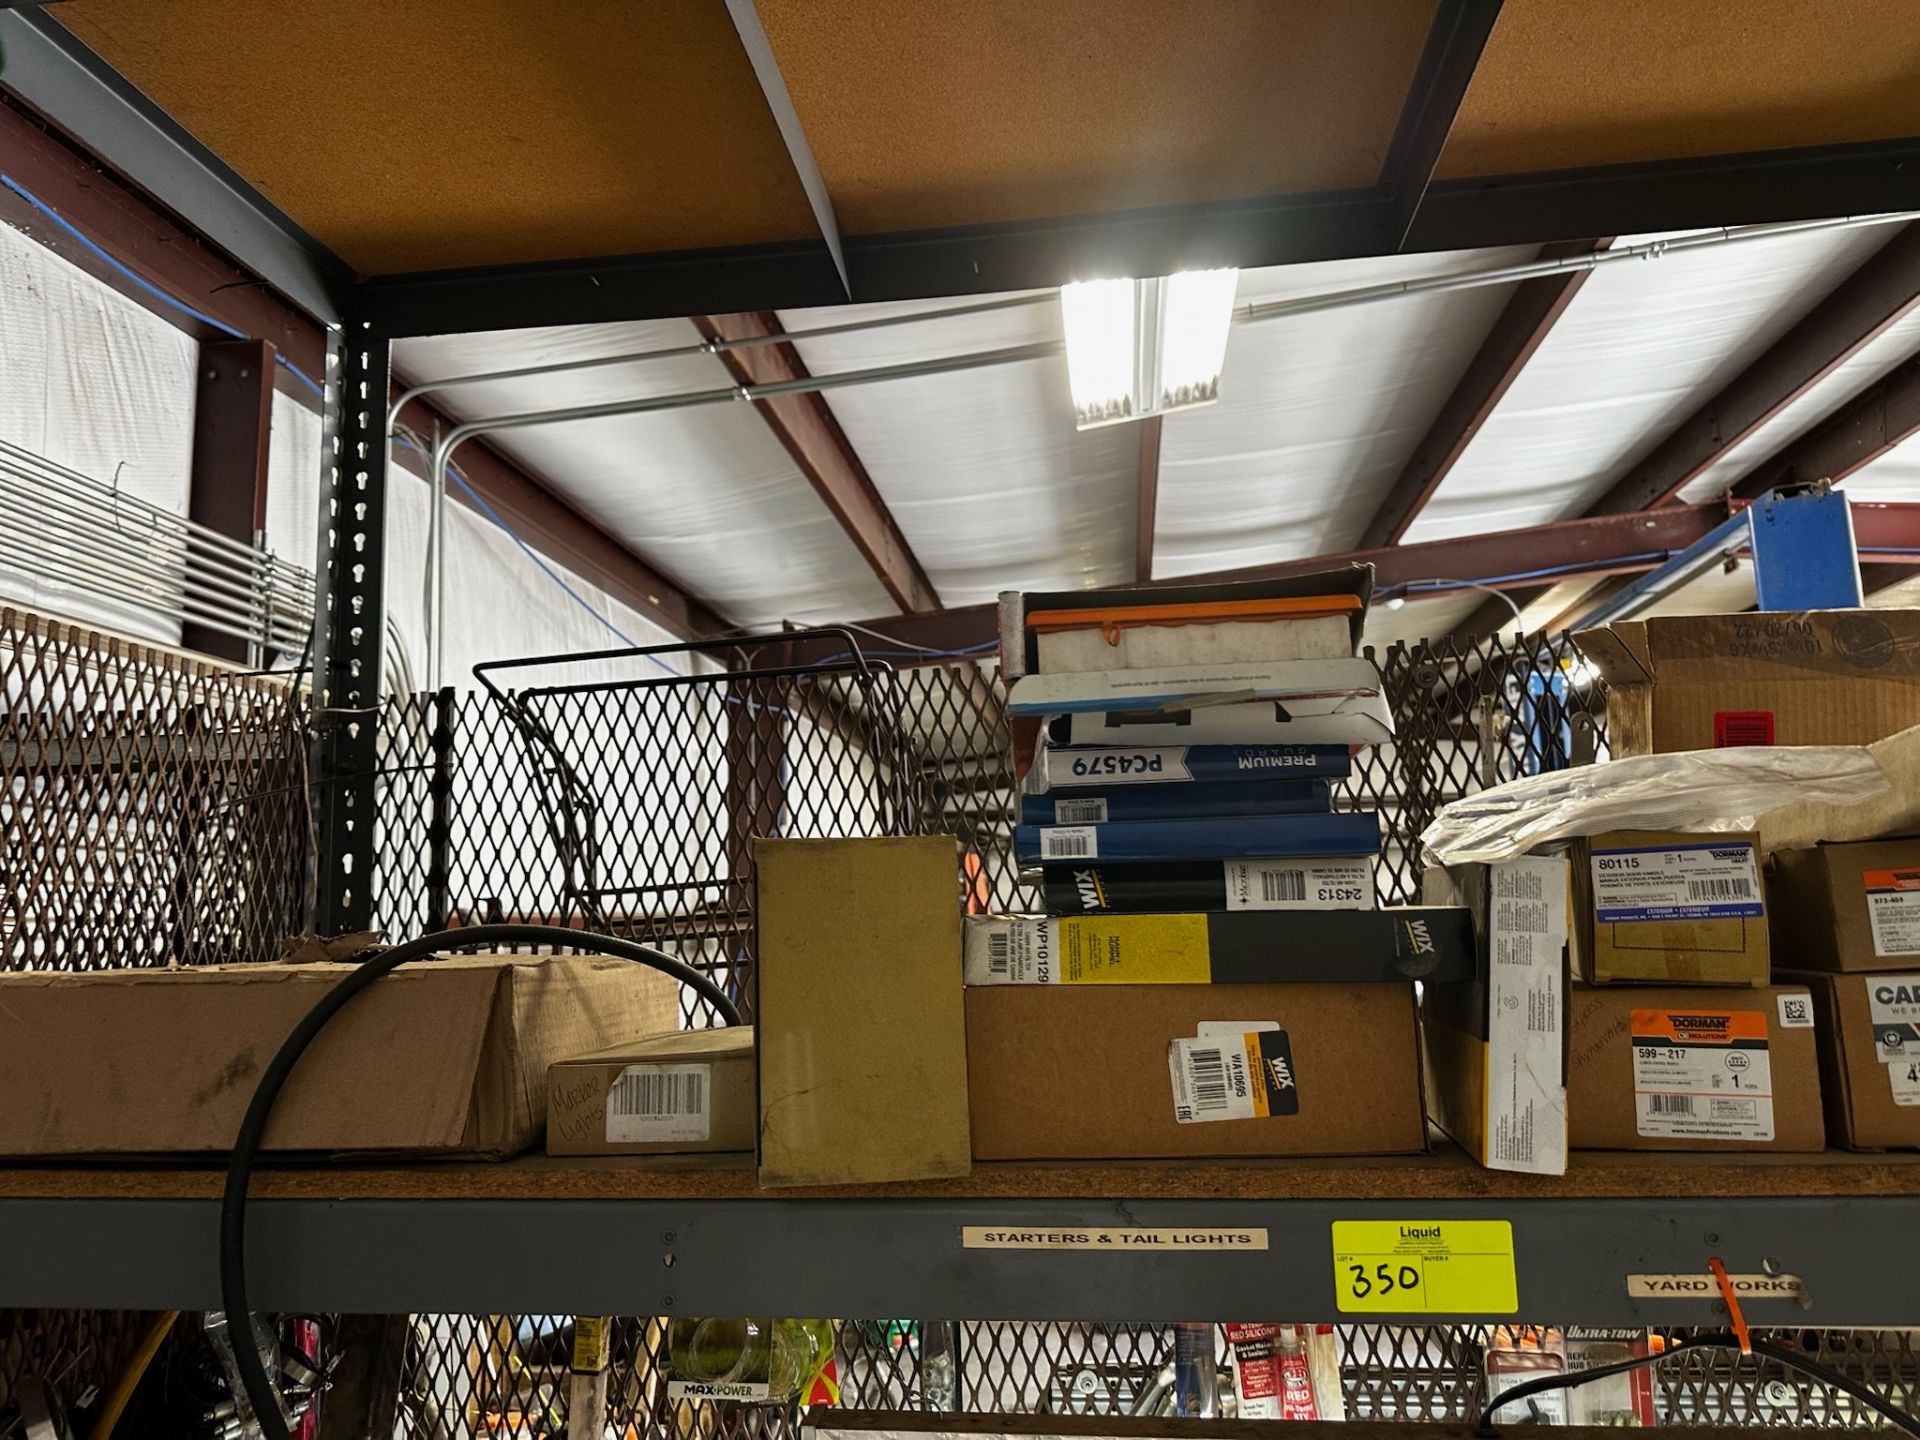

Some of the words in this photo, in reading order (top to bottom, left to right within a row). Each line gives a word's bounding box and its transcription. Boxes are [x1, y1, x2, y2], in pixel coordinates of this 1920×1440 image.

[1072, 754, 1163, 776] PC4579
[1238, 754, 1317, 769] PREMIUM
[1599, 857, 1640, 870] 80115
[1677, 853, 1683, 863] 1
[1073, 870, 1100, 910] WIX
[1318, 889, 1362, 900] 24313
[1411, 919, 1435, 954] WIX
[1037, 921, 1049, 983] WP10129
[1672, 1016, 1730, 1030] DORMAN
[1232, 1053, 1247, 1098] WA10695
[1272, 1056, 1294, 1090] WIX
[1732, 1074, 1739, 1089] 1
[984, 1232, 1090, 1244] STARTERS
[1097, 1233, 1113, 1244] &
[1119, 1233, 1166, 1244] TAIL
[1172, 1233, 1252, 1244] LIGHTS
[1400, 1226, 1441, 1239] Liquid
[1349, 1263, 1419, 1299] 350
[1644, 1280, 1709, 1291] YARD
[1230, 1331, 1244, 1341] RED
[1286, 1390, 1310, 1401] RED
